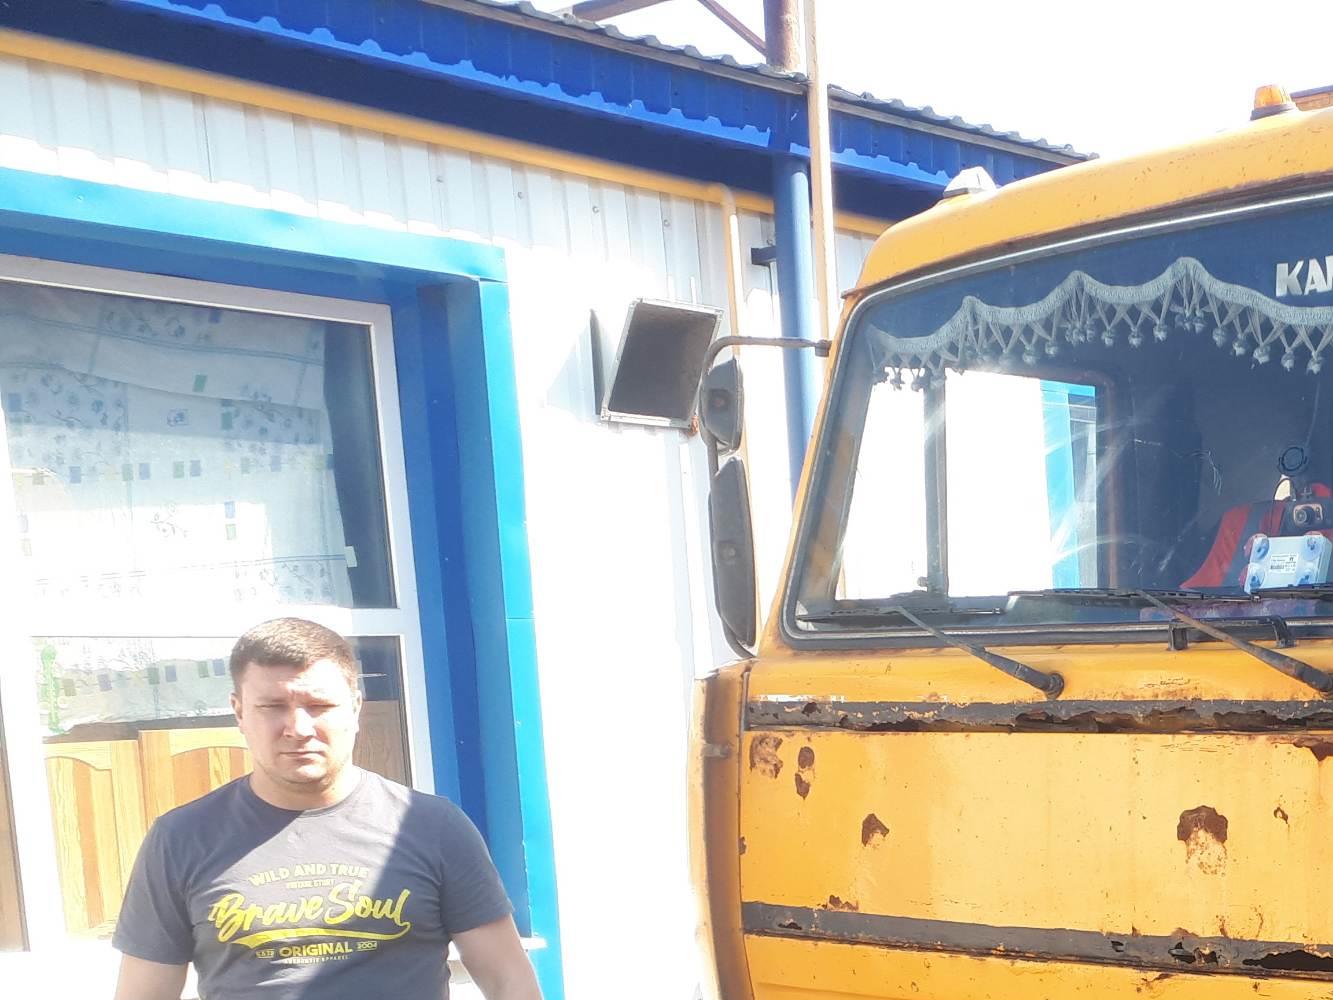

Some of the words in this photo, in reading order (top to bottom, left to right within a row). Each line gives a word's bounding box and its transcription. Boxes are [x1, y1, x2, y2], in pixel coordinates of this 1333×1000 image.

[248, 867, 290, 886] WILD
[294, 863, 327, 876] AND
[330, 863, 369, 878] TRUE
[208, 893, 324, 942] Brave
[324, 881, 411, 926] Soul
[279, 941, 353, 957] ORIGINAL
